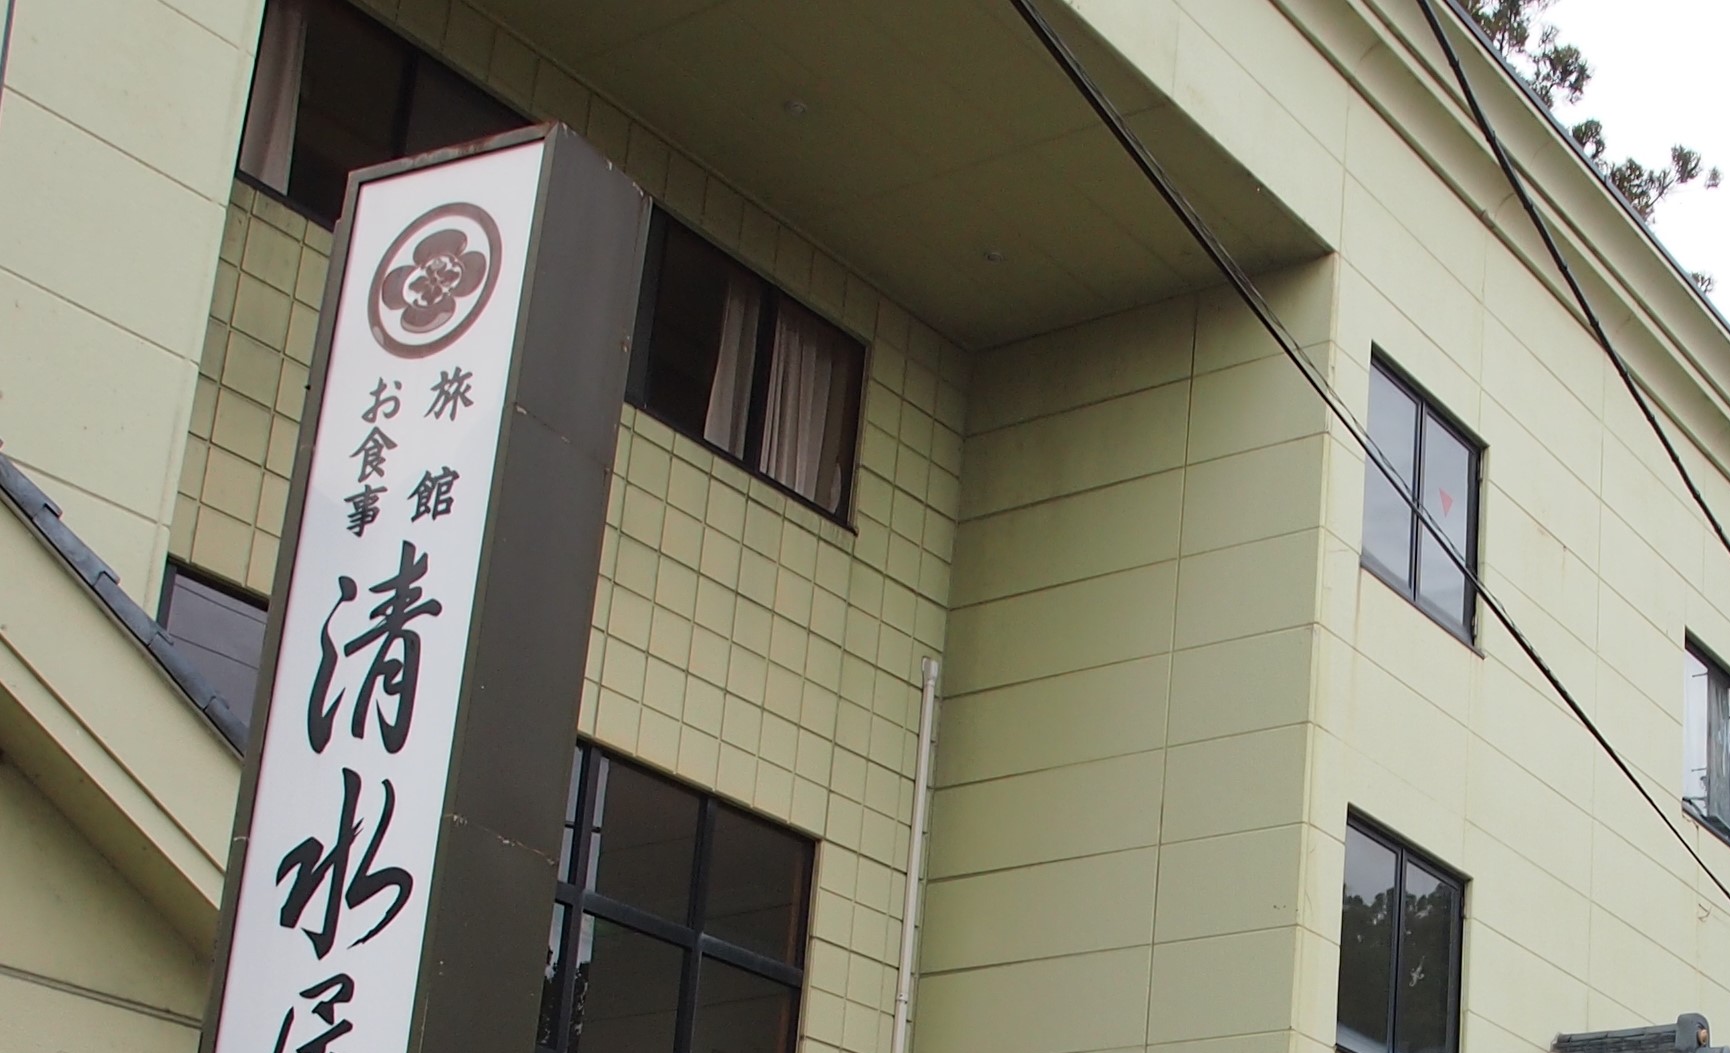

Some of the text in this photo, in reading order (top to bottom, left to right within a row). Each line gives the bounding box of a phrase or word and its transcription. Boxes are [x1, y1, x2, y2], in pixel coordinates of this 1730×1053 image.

[343, 376, 403, 538] お食事
[408, 366, 475, 522] 旅館
